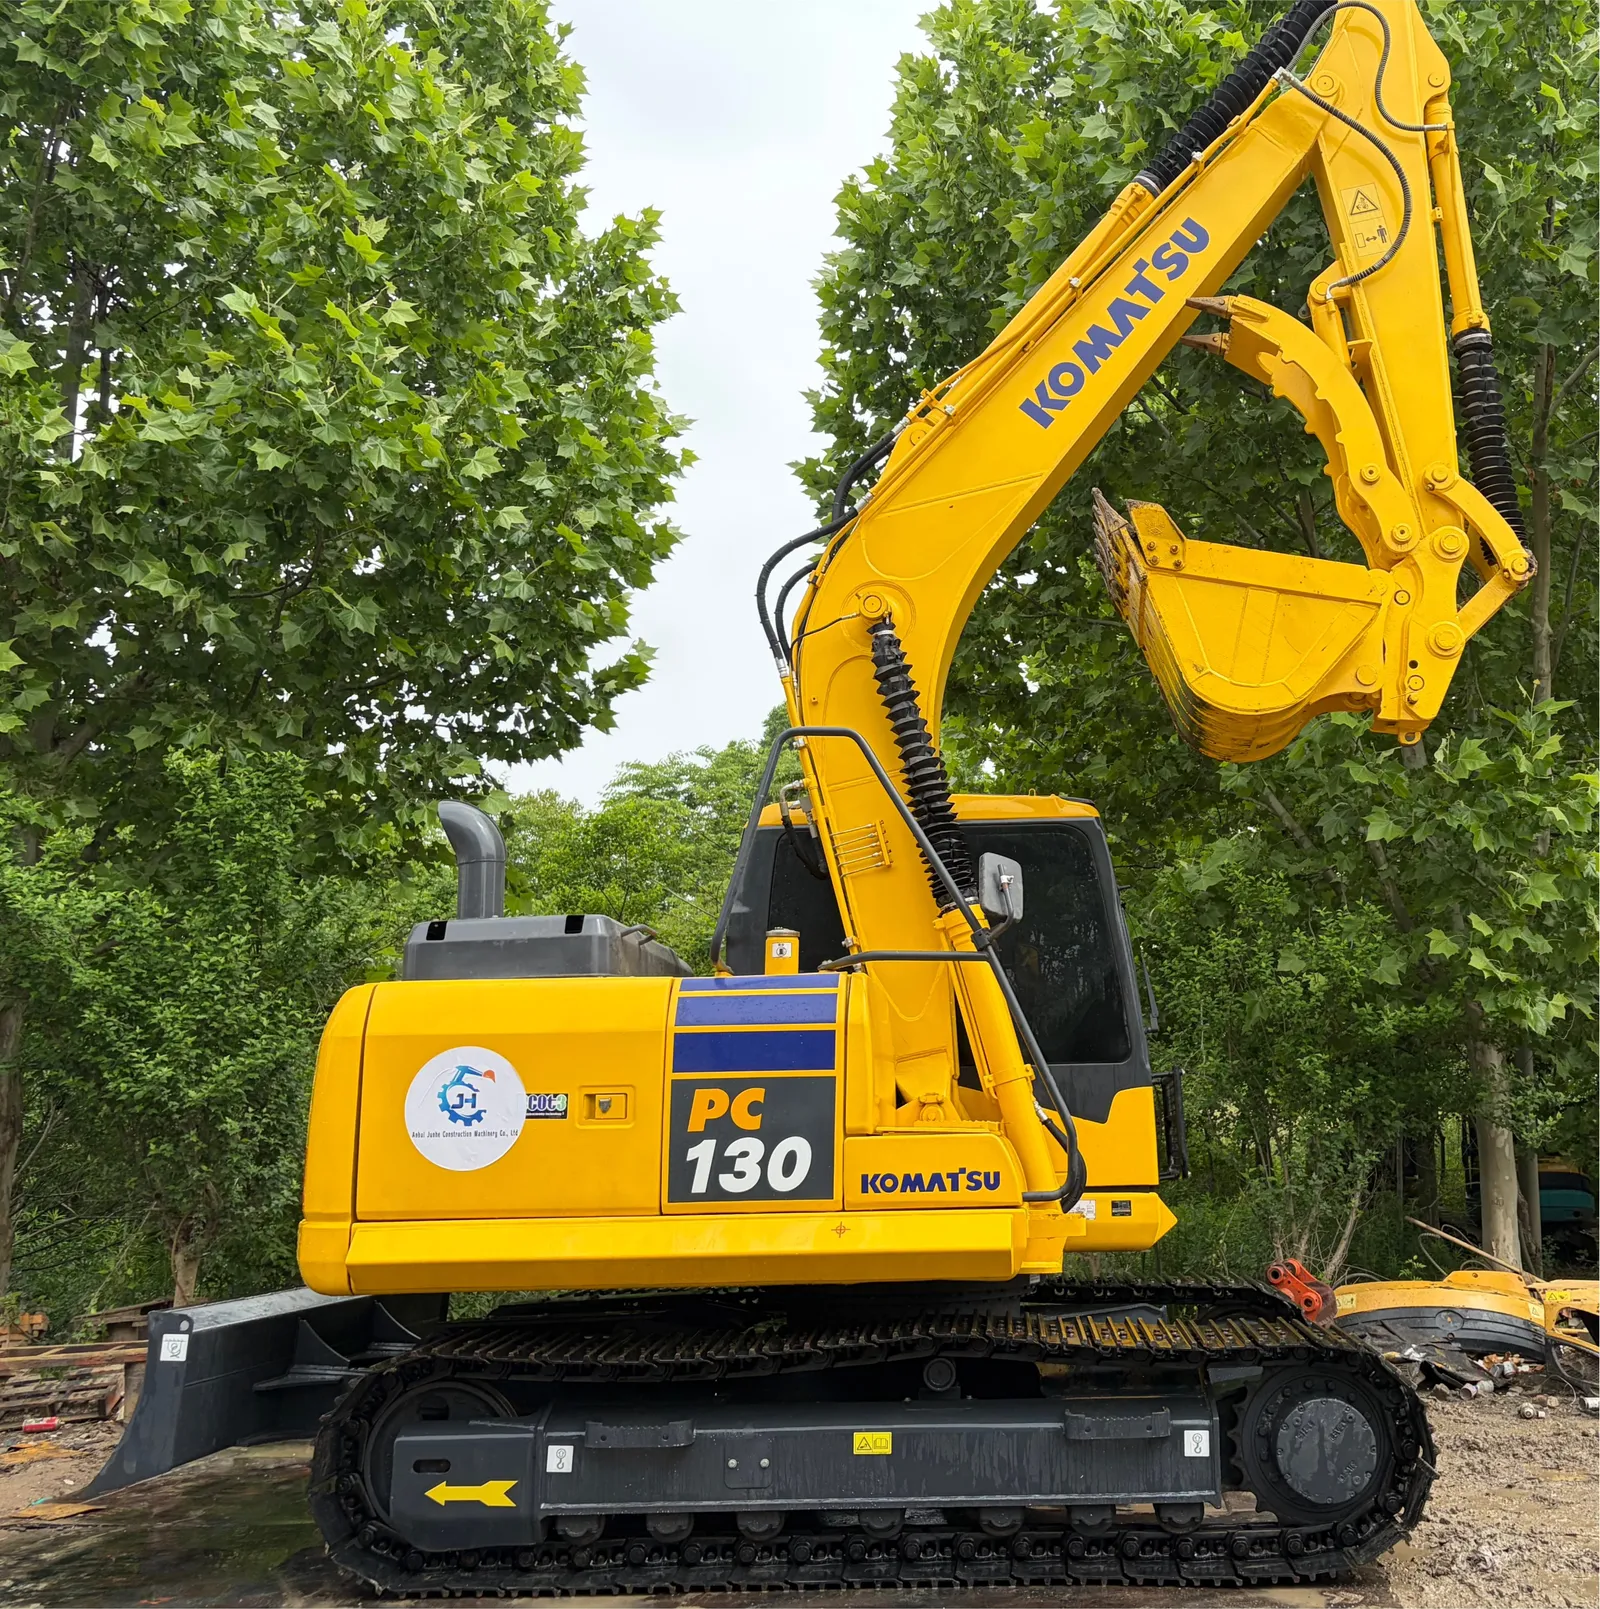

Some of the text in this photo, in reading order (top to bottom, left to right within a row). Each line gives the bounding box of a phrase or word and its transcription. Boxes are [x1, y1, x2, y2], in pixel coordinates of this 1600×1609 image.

[1018, 217, 1210, 430] KOMATSU
[687, 1087, 766, 1132] PC
[442, 1130, 472, 1138] Construction
[474, 1130, 498, 1139] Machinery
[686, 1136, 812, 1193] 130
[861, 1167, 1001, 1194] KOMATSU
